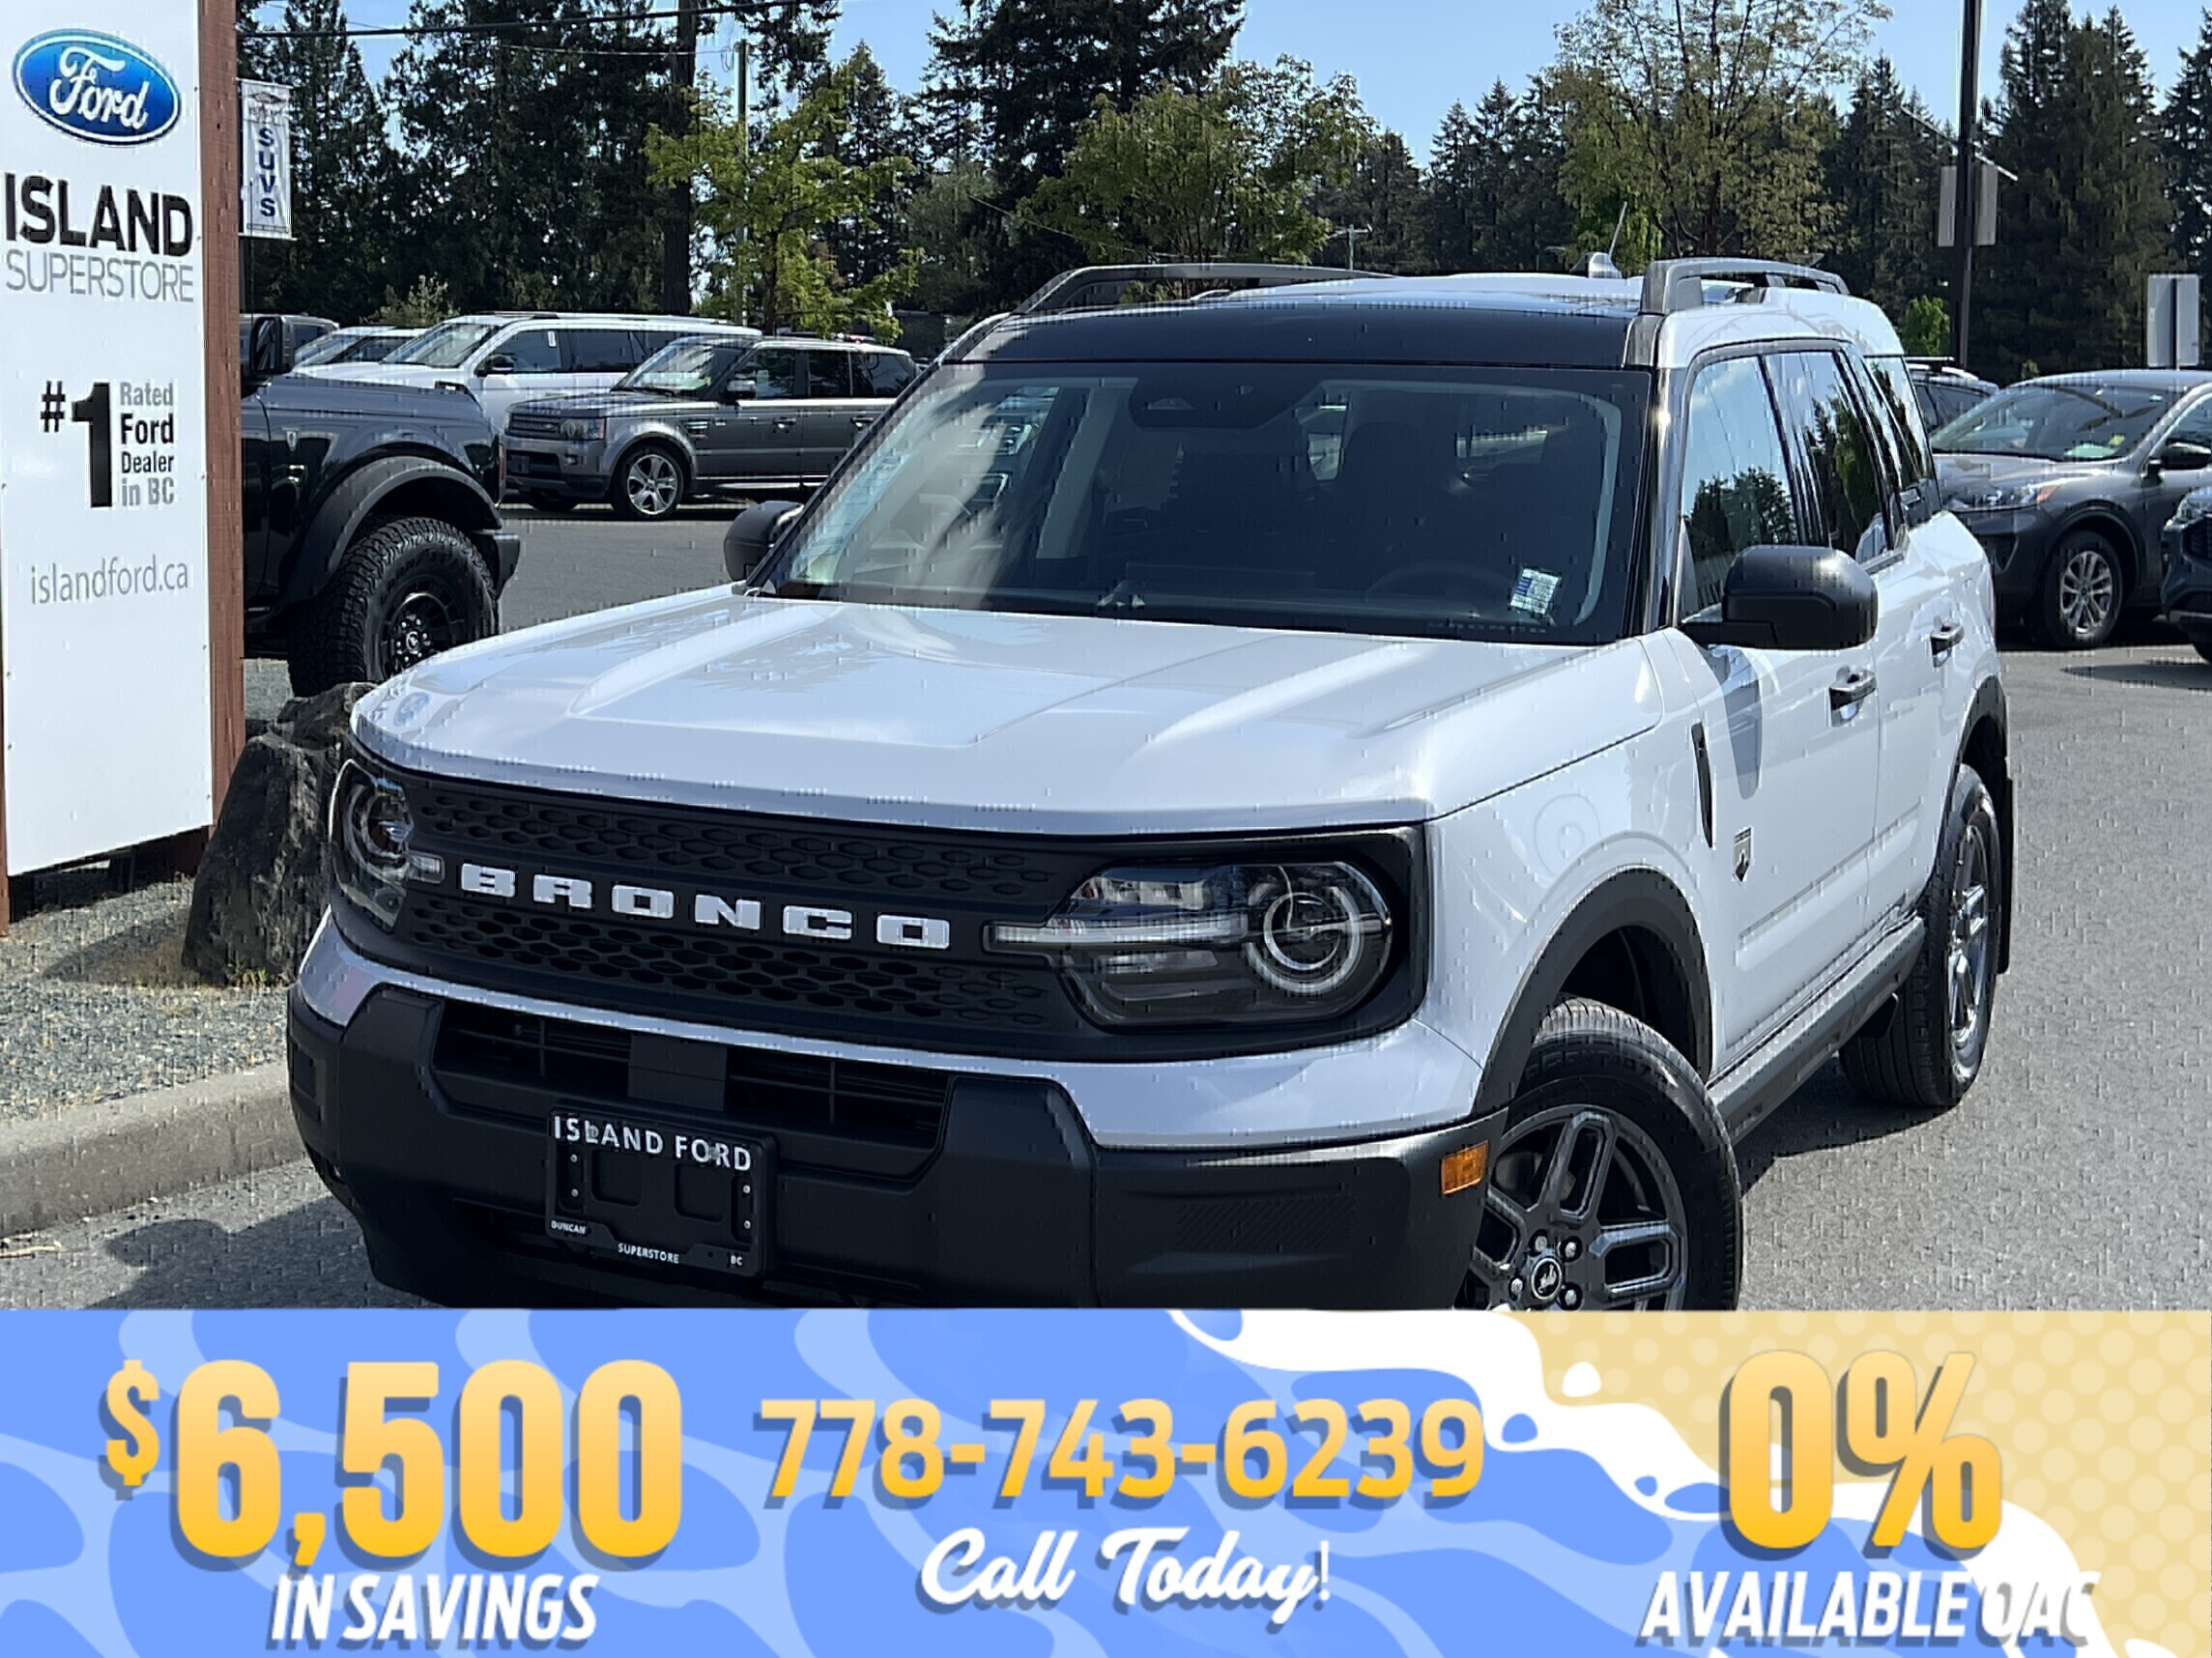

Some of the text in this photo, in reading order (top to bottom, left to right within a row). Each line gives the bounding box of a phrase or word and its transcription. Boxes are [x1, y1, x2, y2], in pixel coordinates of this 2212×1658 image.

[50, 45, 150, 130] Ford
[4, 172, 193, 258] ISLAND
[6, 248, 194, 302] SUPERSTORE
[120, 382, 174, 407] Rated
[121, 413, 174, 444] Ford
[121, 450, 175, 473] Dealer
[122, 476, 175, 507] in BC
[31, 554, 188, 605] islandford.ca
[461, 862, 951, 950] BRONCO
[554, 1115, 752, 1172] ISLAND FORD
[551, 1219, 587, 1236] DUNCAN
[618, 1242, 680, 1265] SUPERSTORE
[730, 1254, 743, 1267] BC
